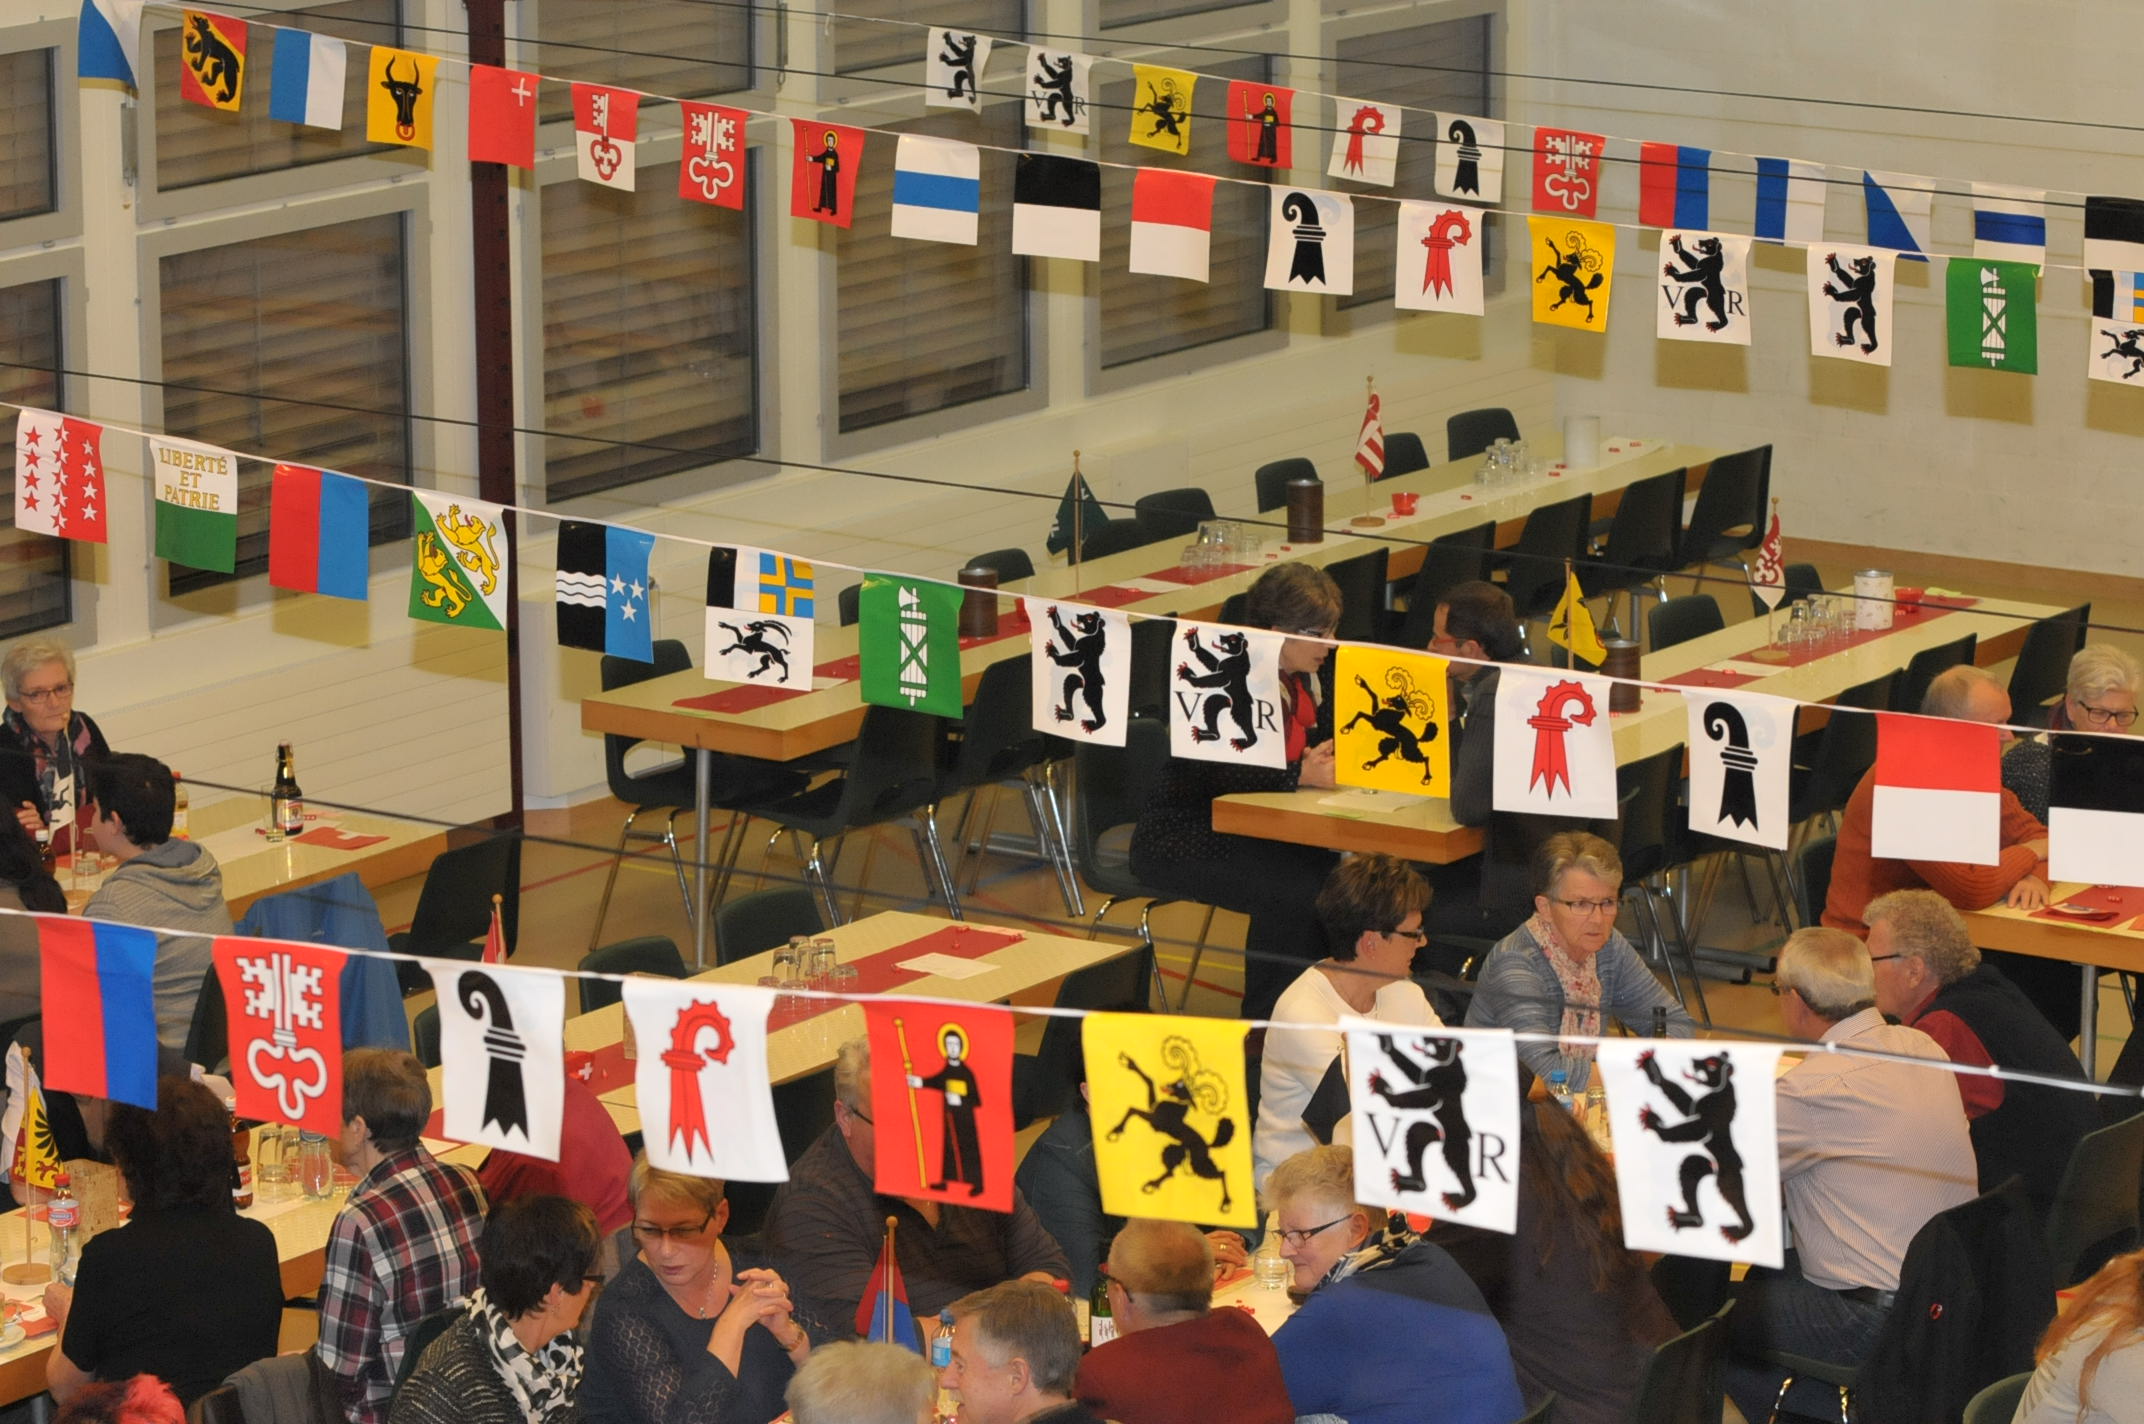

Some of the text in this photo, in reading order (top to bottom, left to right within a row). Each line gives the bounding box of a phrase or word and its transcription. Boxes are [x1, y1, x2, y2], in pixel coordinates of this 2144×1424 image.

[1031, 90, 1087, 117] V R
[1661, 285, 1746, 316] V R
[159, 447, 228, 475] LIBERTÉ
[179, 470, 202, 489] ET
[164, 484, 220, 511] PATRIE
[1174, 691, 1279, 733] V R
[1365, 1111, 1510, 1184] V R
